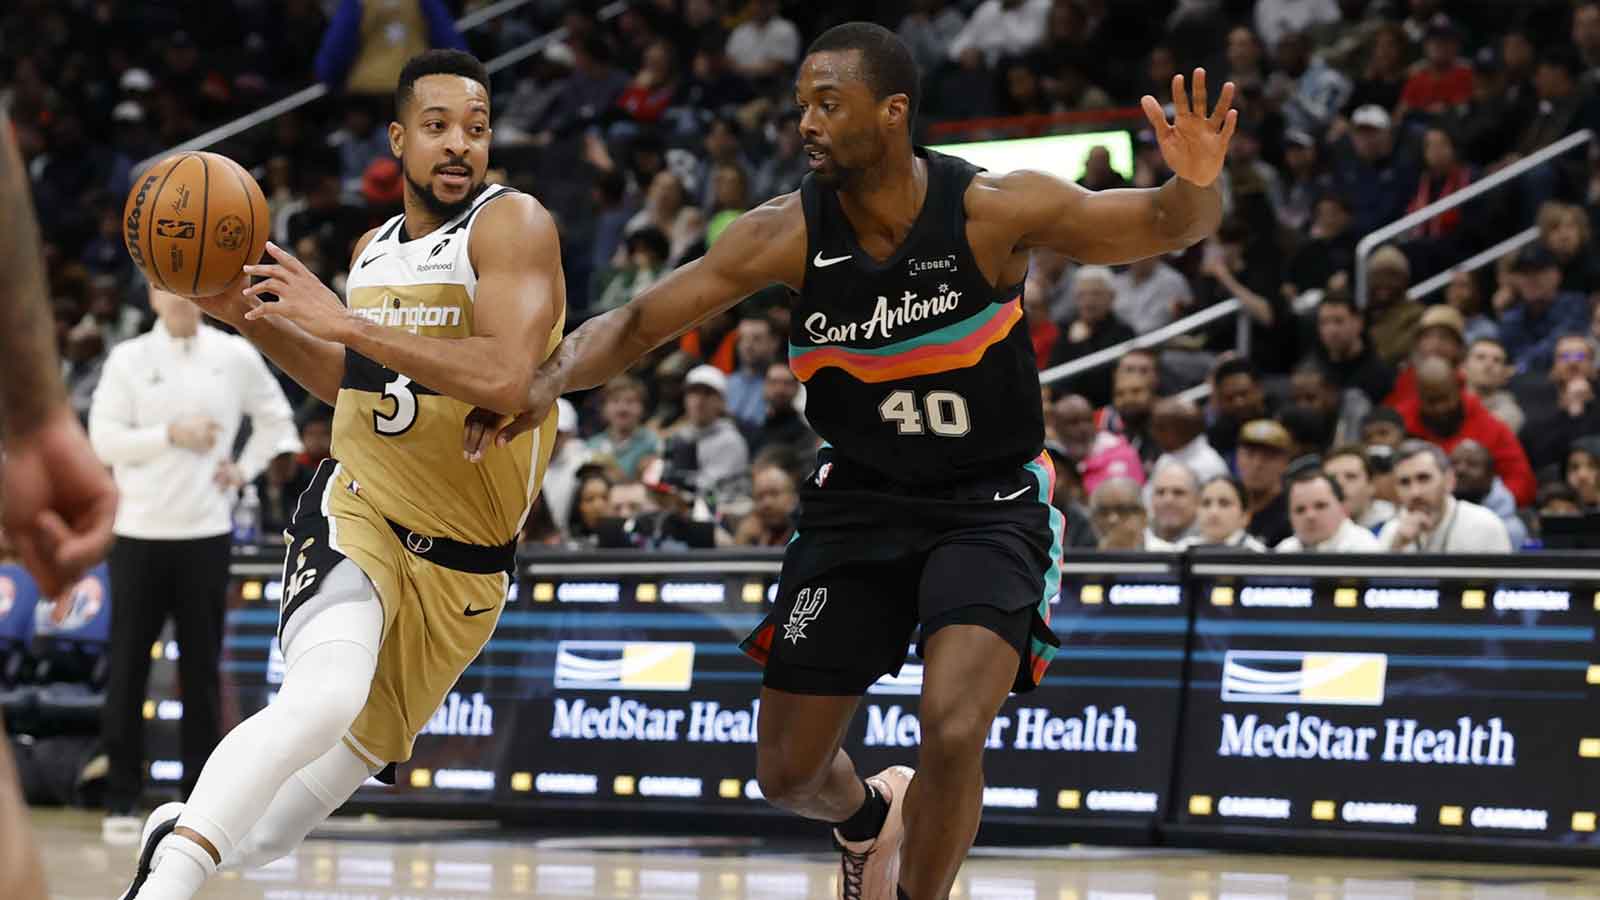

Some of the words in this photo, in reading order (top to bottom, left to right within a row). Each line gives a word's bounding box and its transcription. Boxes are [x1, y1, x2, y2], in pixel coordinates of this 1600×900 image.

[127, 176, 159, 267] Wilson
[416, 263, 453, 273] Robinhood
[915, 260, 951, 270] LEDGER
[804, 312, 857, 344] San
[860, 283, 962, 340] Antonio
[373, 373, 419, 437] 3
[878, 389, 972, 438] 40
[418, 692, 494, 735] alth
[551, 696, 685, 741] MedStar
[688, 698, 760, 743] Heal
[1013, 705, 1137, 752] Health
[1218, 711, 1377, 761] MedStar
[1381, 716, 1516, 766] Health
